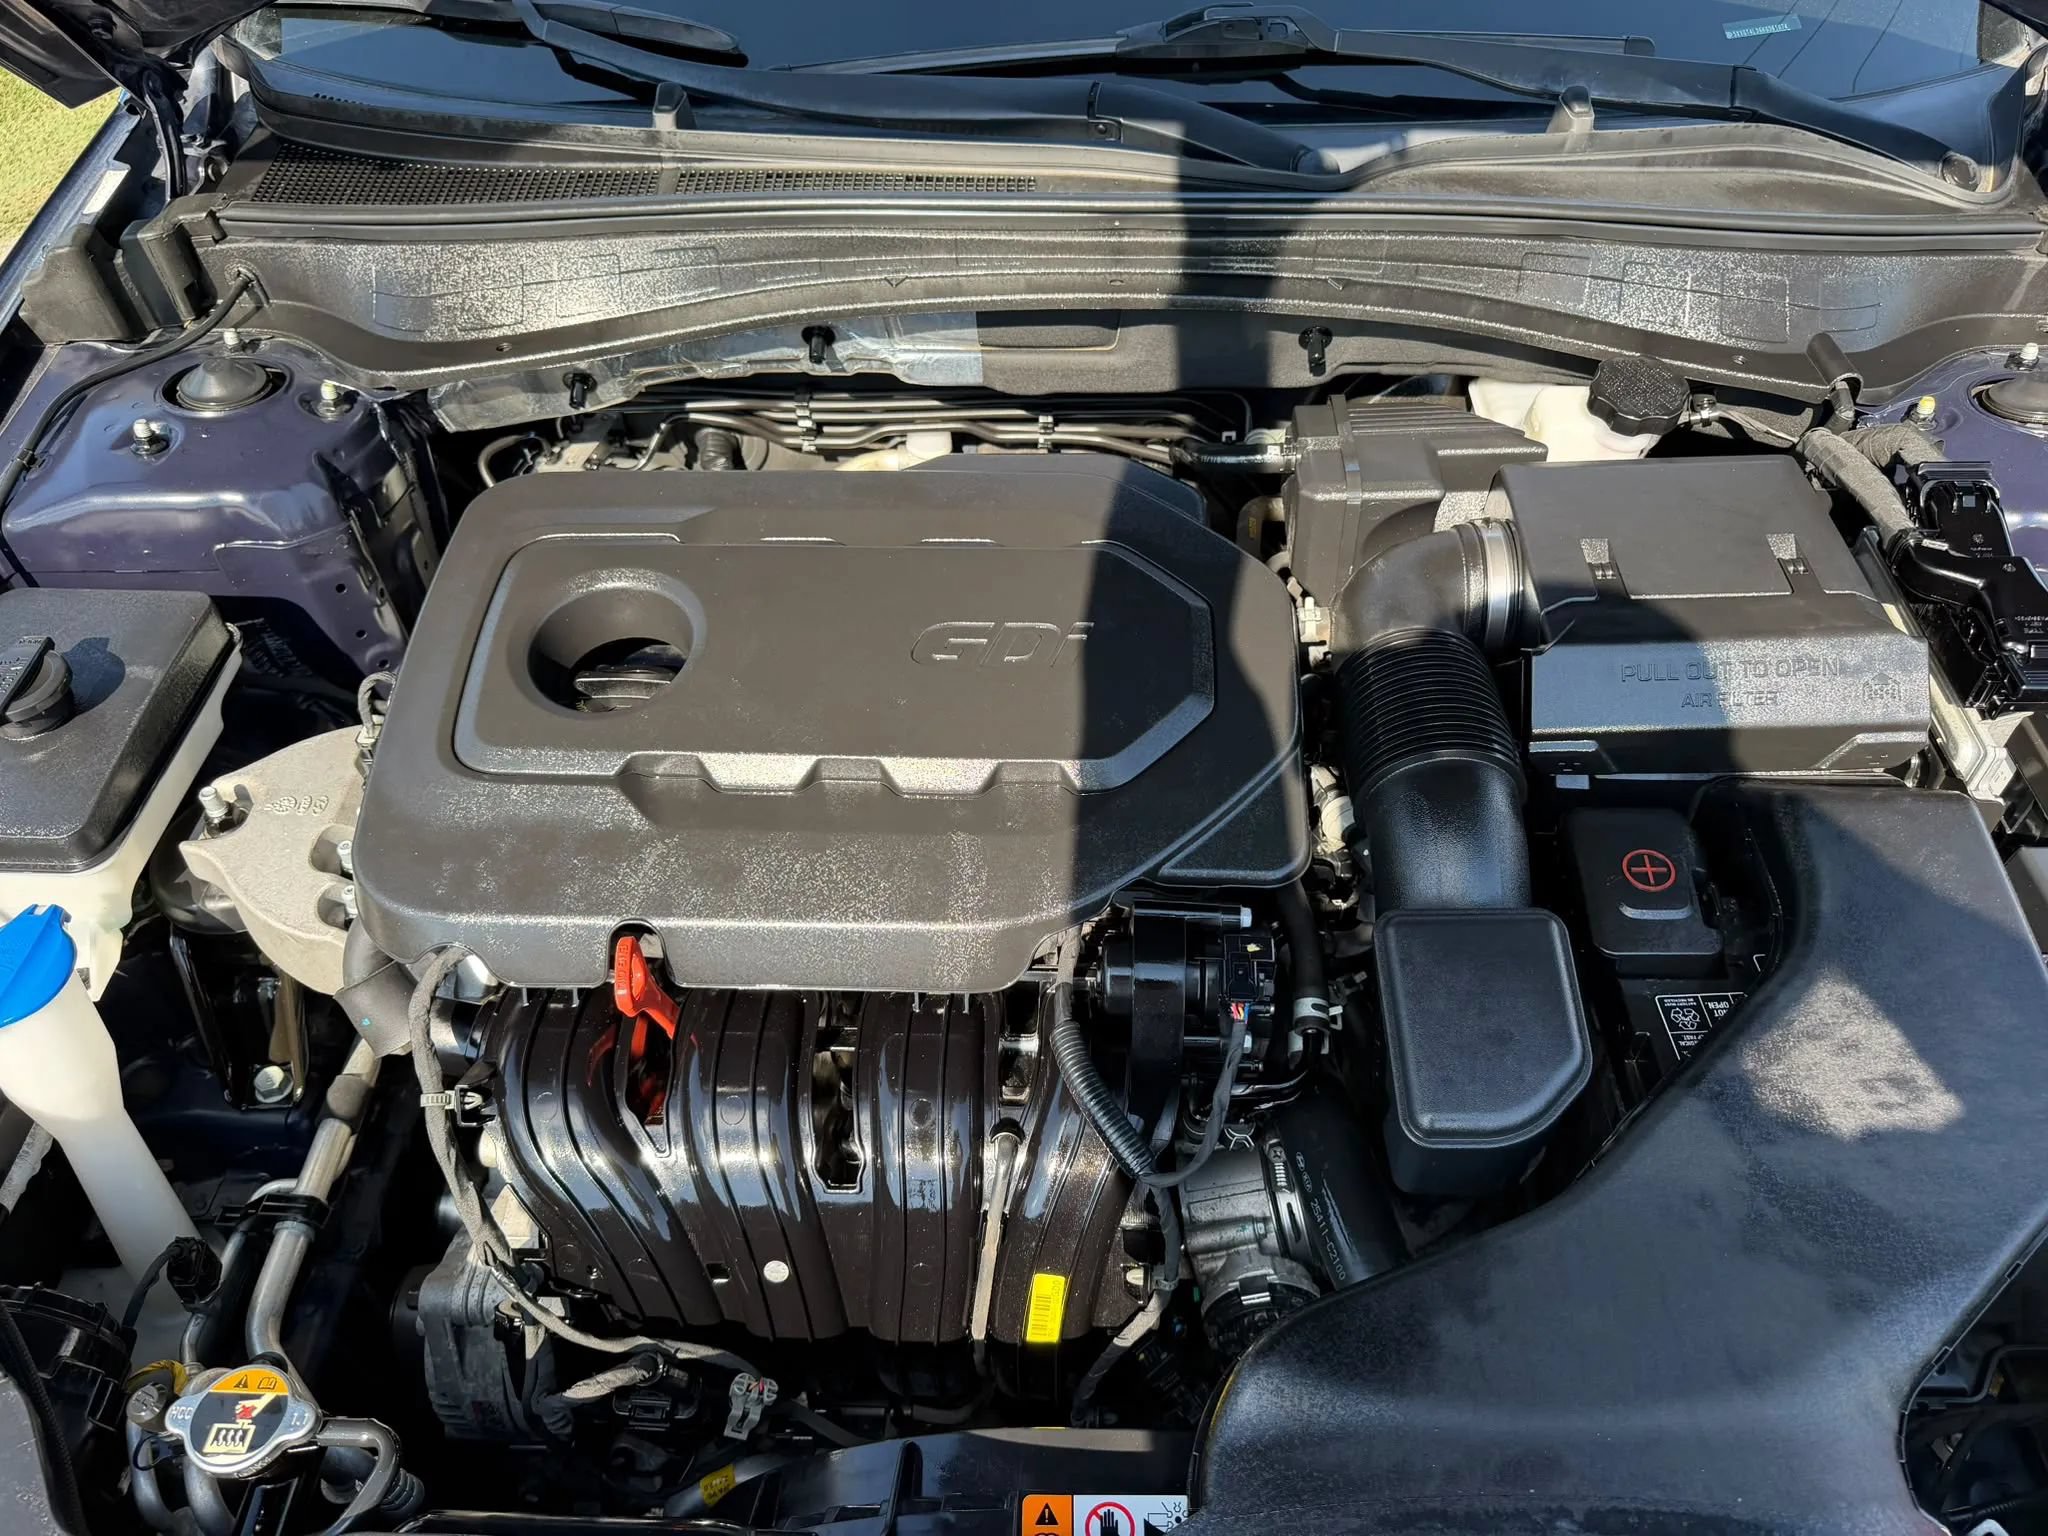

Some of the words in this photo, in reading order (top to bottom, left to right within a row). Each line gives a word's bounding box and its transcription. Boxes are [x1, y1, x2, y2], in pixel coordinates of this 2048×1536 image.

[911, 621, 1095, 667] GDi
[1621, 662, 1680, 682] PULL
[1685, 660, 1732, 680] OUT
[1740, 659, 1769, 678] TO
[1776, 656, 1839, 677] OPEN
[1681, 692, 1713, 708] AIR
[1718, 689, 1780, 708] FILTER
[1705, 1001, 1729, 1009] OPEN.
[1311, 1198, 1346, 1280] 25411-C2100
[170, 1406, 193, 1420] HCC
[290, 1412, 308, 1426] 1.1
